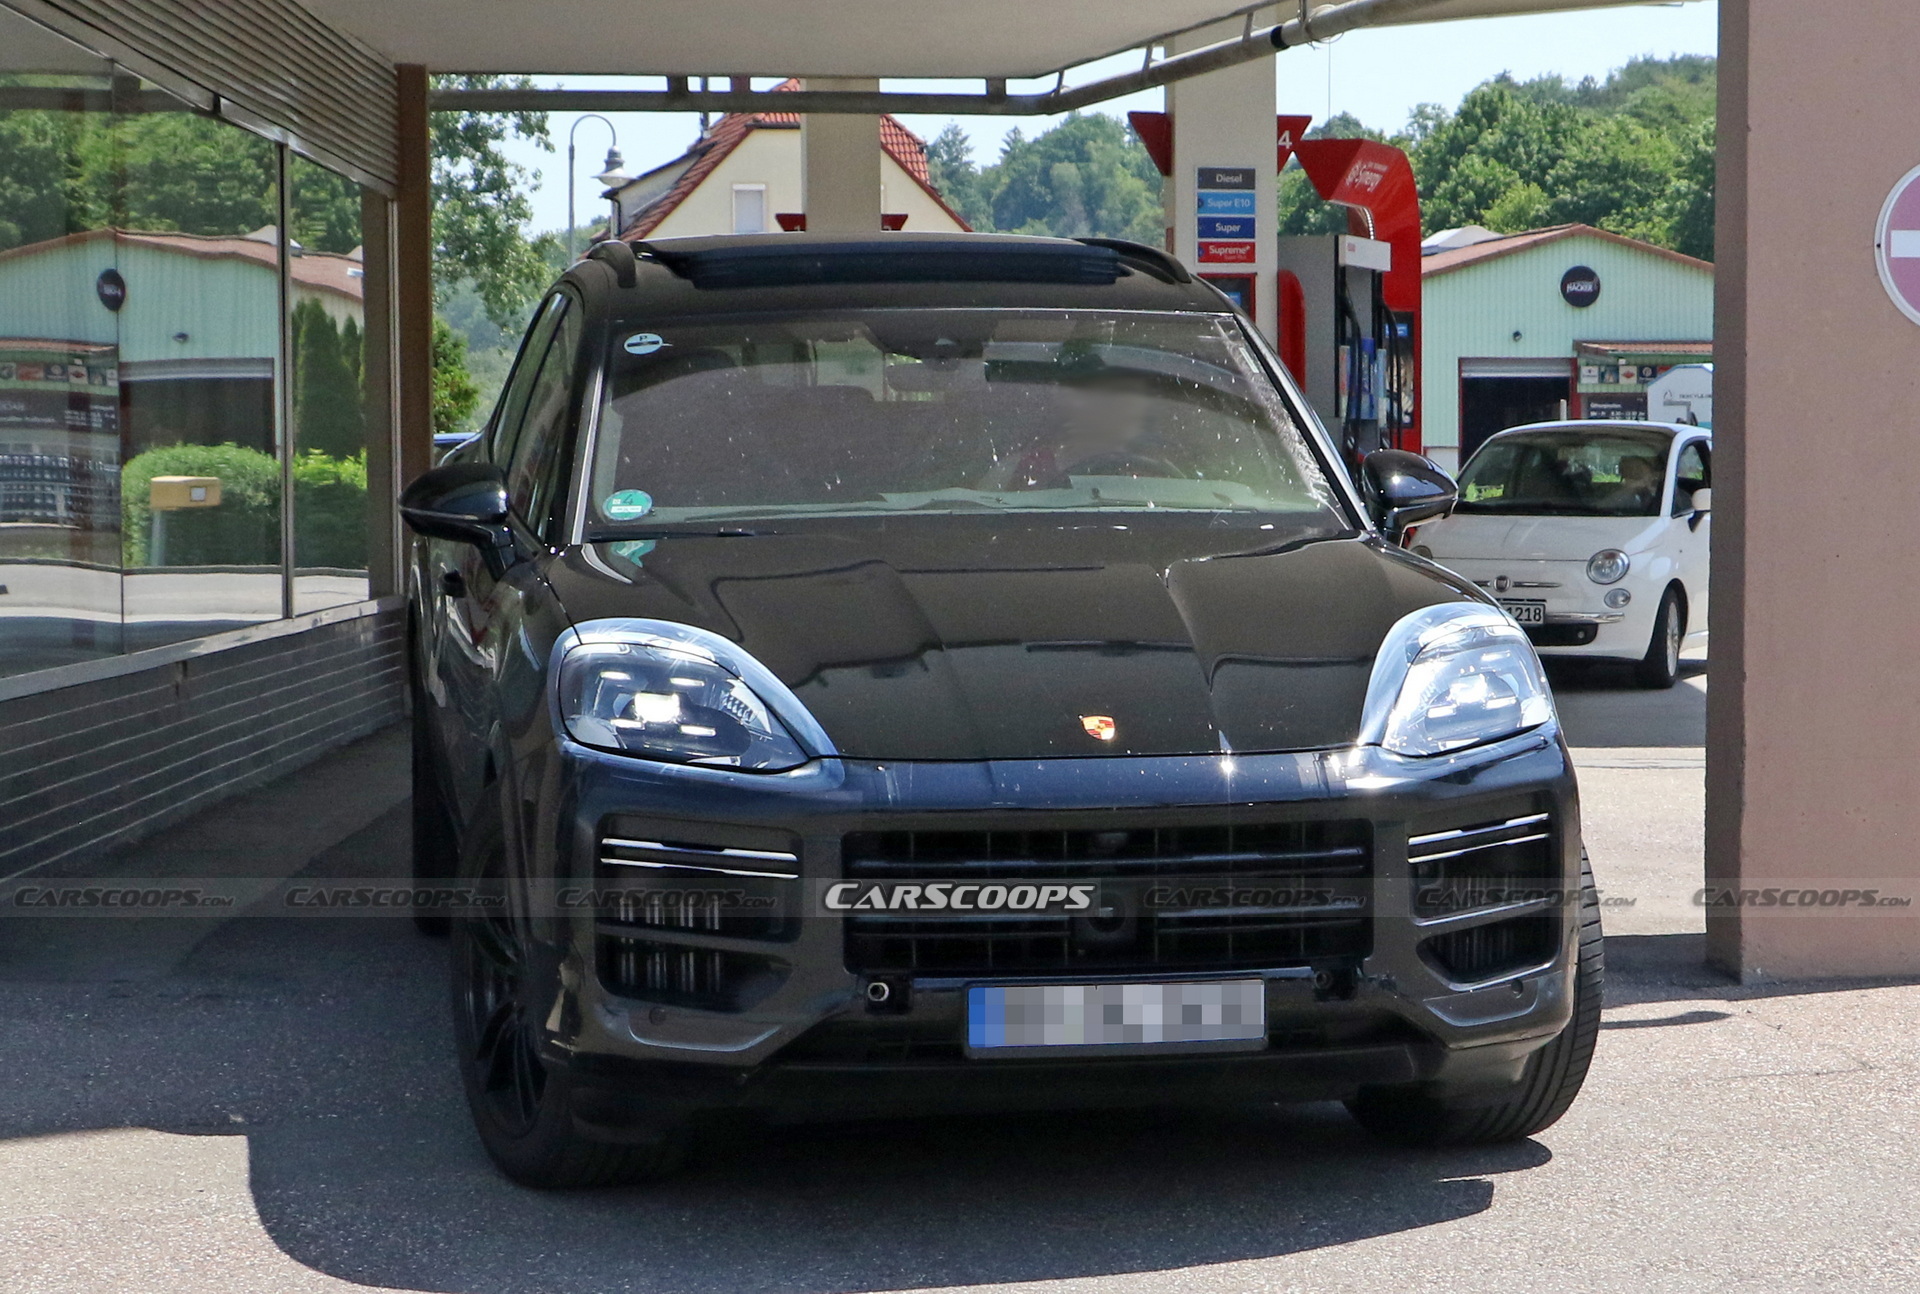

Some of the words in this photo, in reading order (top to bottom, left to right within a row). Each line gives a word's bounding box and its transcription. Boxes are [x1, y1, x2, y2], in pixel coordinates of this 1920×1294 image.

[1278, 130, 1292, 149] 4
[1216, 173, 1242, 183] Diesel
[1207, 198, 1232, 210] Super
[1234, 199, 1251, 208] E10
[1215, 222, 1241, 235] Super
[622, 493, 634, 505] 4
